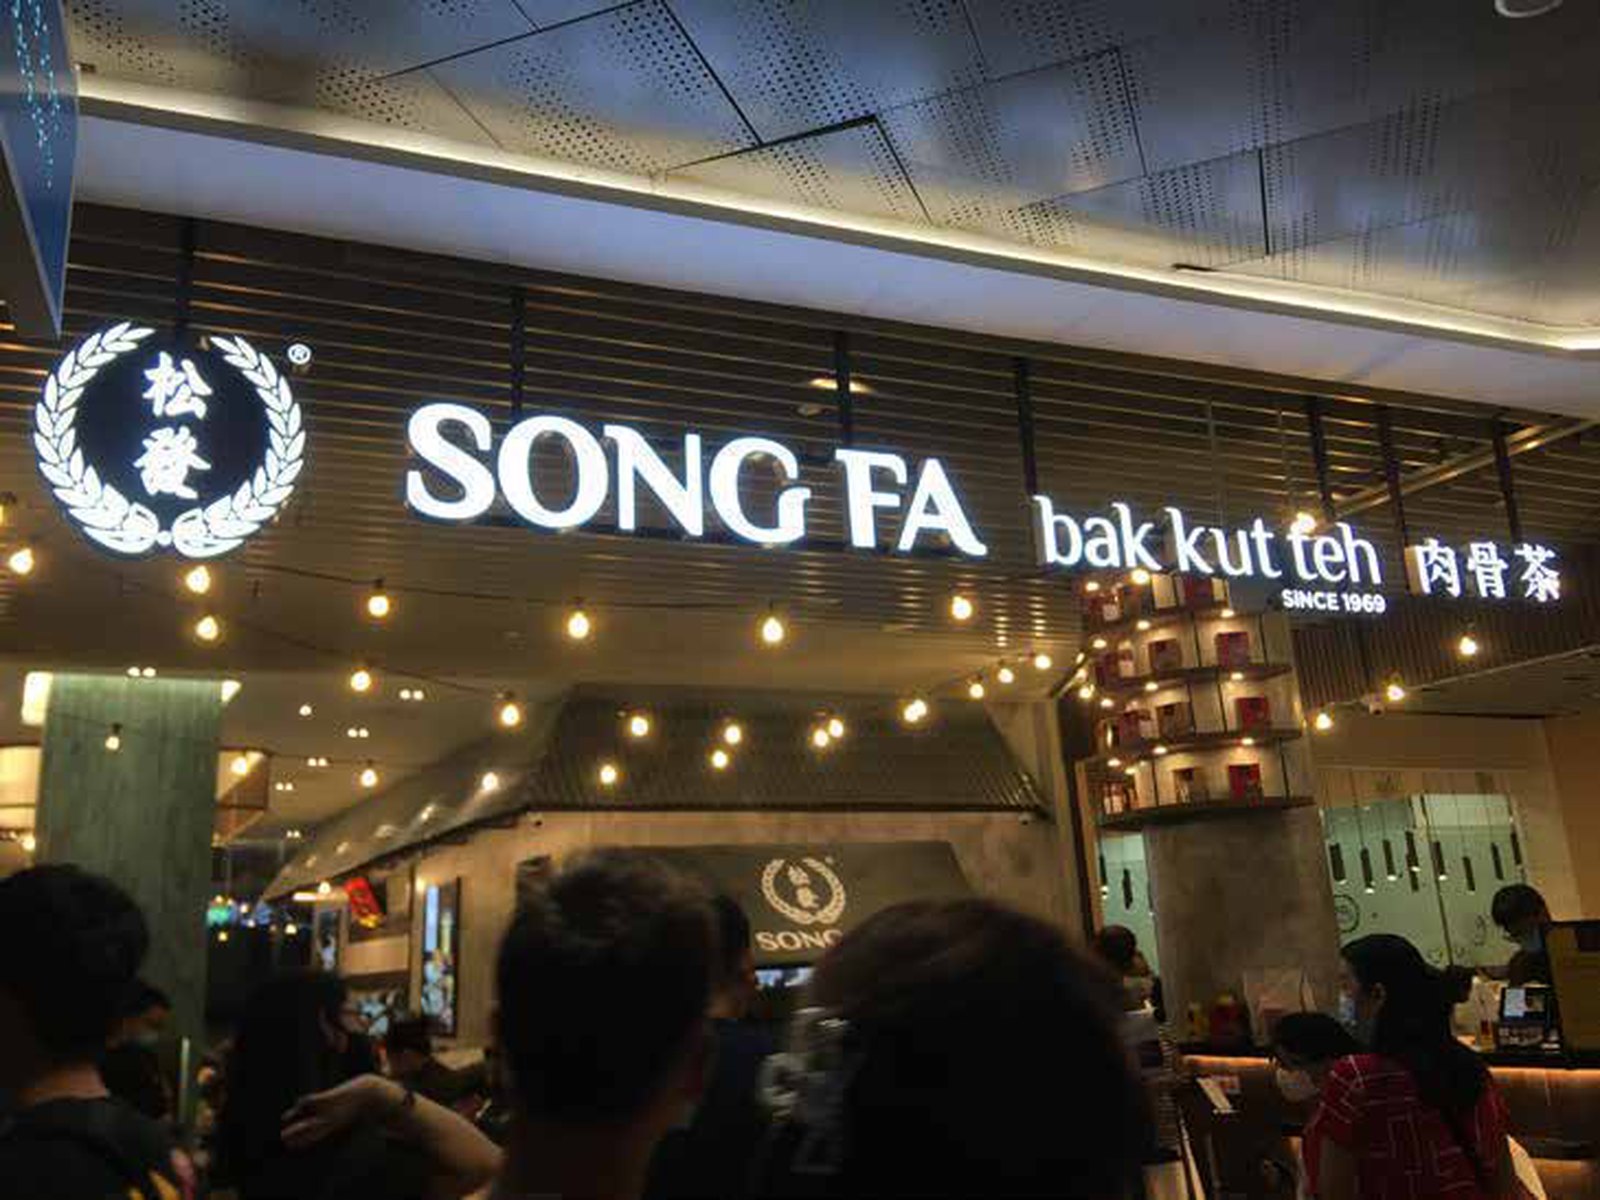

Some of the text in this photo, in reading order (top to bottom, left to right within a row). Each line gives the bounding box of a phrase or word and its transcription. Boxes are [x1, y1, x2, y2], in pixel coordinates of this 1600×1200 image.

[405, 402, 989, 557] SONG FA
[1034, 495, 1382, 586] bak kut teh
[1414, 537, 1562, 602] 肉骨茶
[1281, 588, 1386, 614] SINCE 1969
